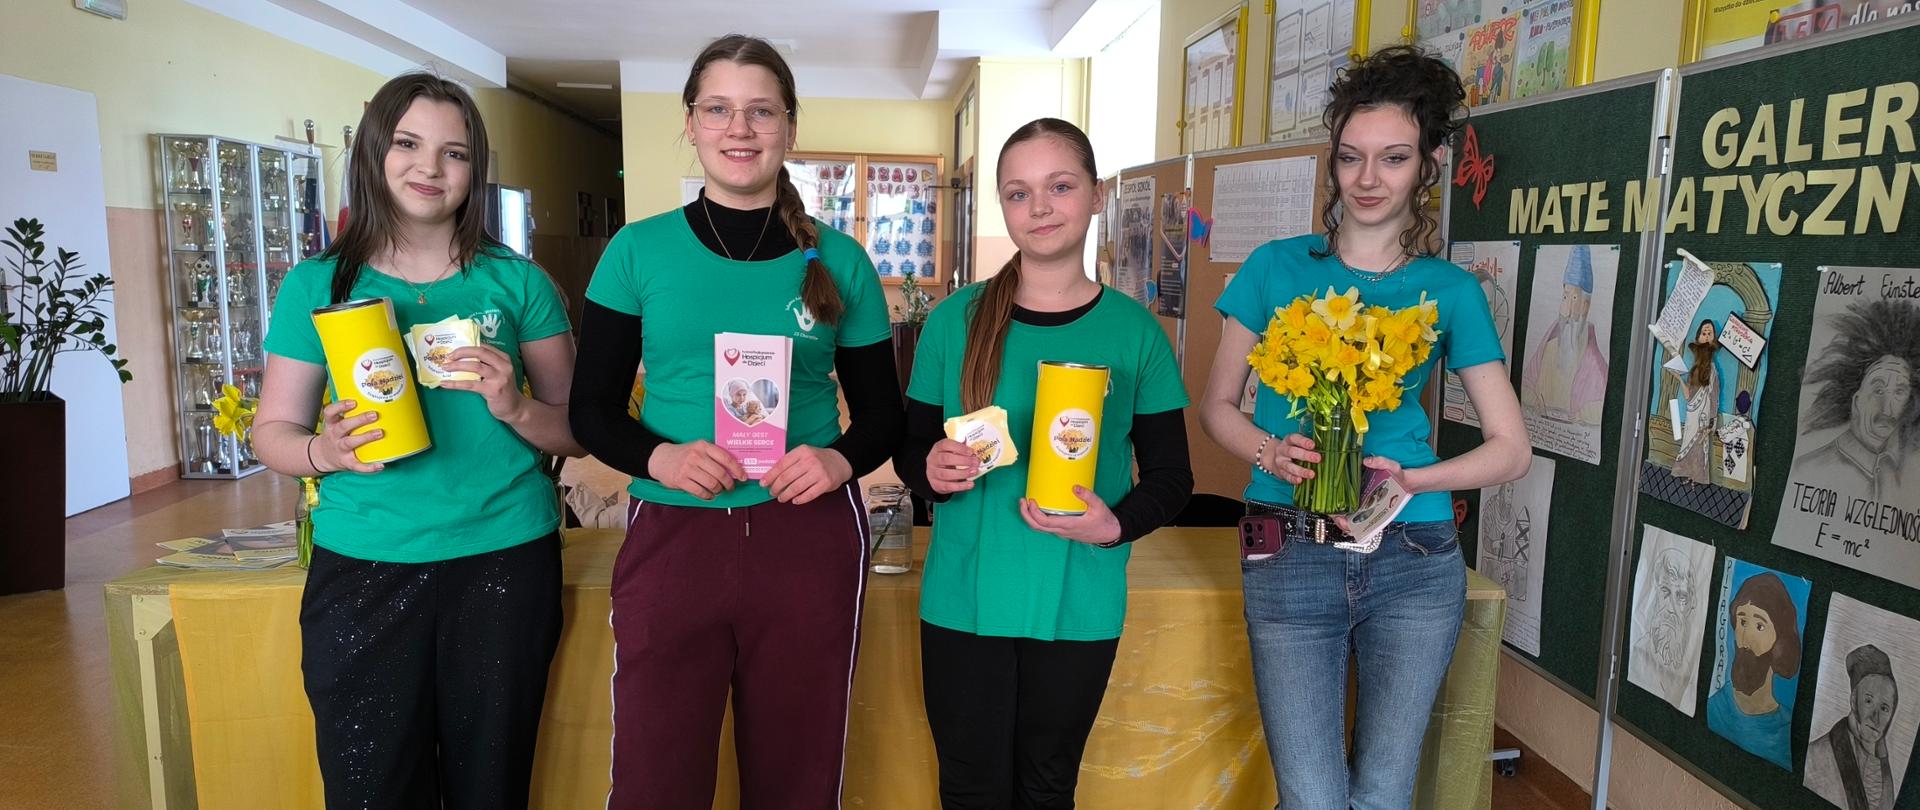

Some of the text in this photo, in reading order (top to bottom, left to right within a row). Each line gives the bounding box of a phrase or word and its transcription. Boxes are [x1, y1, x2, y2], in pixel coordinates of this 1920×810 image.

[1702, 81, 1919, 169] GALER
[1622, 161, 1920, 236] MATYCZN
[1823, 271, 1865, 295] Albert
[1793, 482, 1837, 517] TEORIA
[1815, 522, 1829, 548] E
[1843, 539, 1870, 557] mc²
[1715, 559, 1733, 690] PITAGORAS
